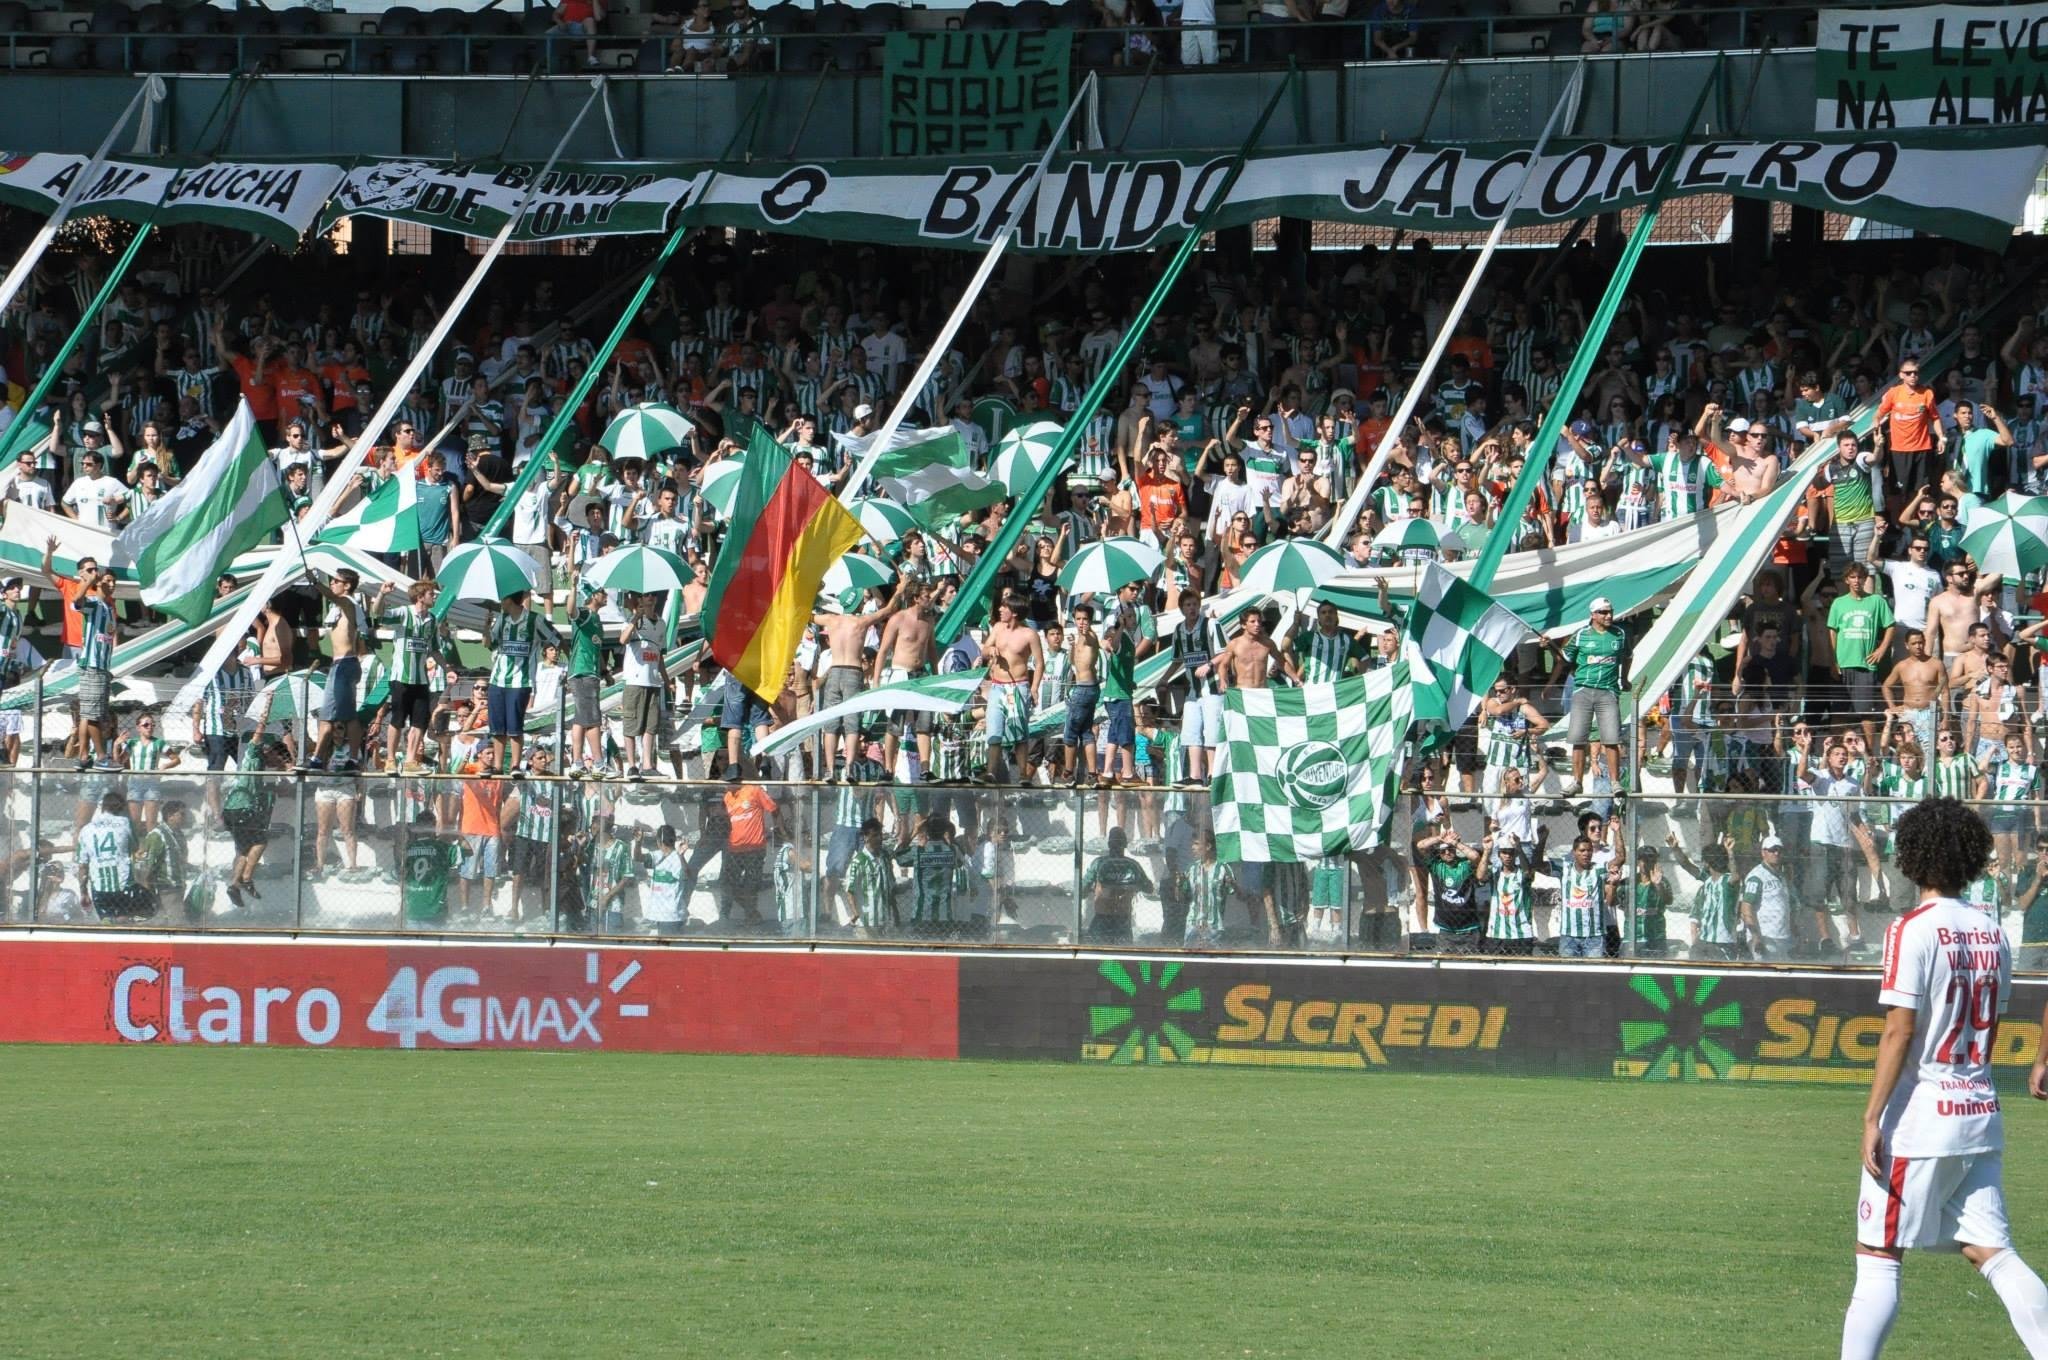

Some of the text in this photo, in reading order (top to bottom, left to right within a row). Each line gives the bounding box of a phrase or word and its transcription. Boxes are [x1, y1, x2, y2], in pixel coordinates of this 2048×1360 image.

[903, 30, 1048, 69] JUVE
[1840, 24, 1900, 70] TE
[892, 69, 1060, 120] ROQUE
[1836, 73, 2048, 129] NA ALMA
[413, 180, 488, 225] DE
[760, 140, 1901, 251] O BANDO JACONERO
[113, 964, 341, 1045] Claro
[365, 966, 486, 1049] 4G
[1216, 984, 1508, 1066] SICREDI
[1936, 974, 2000, 1065] 29
